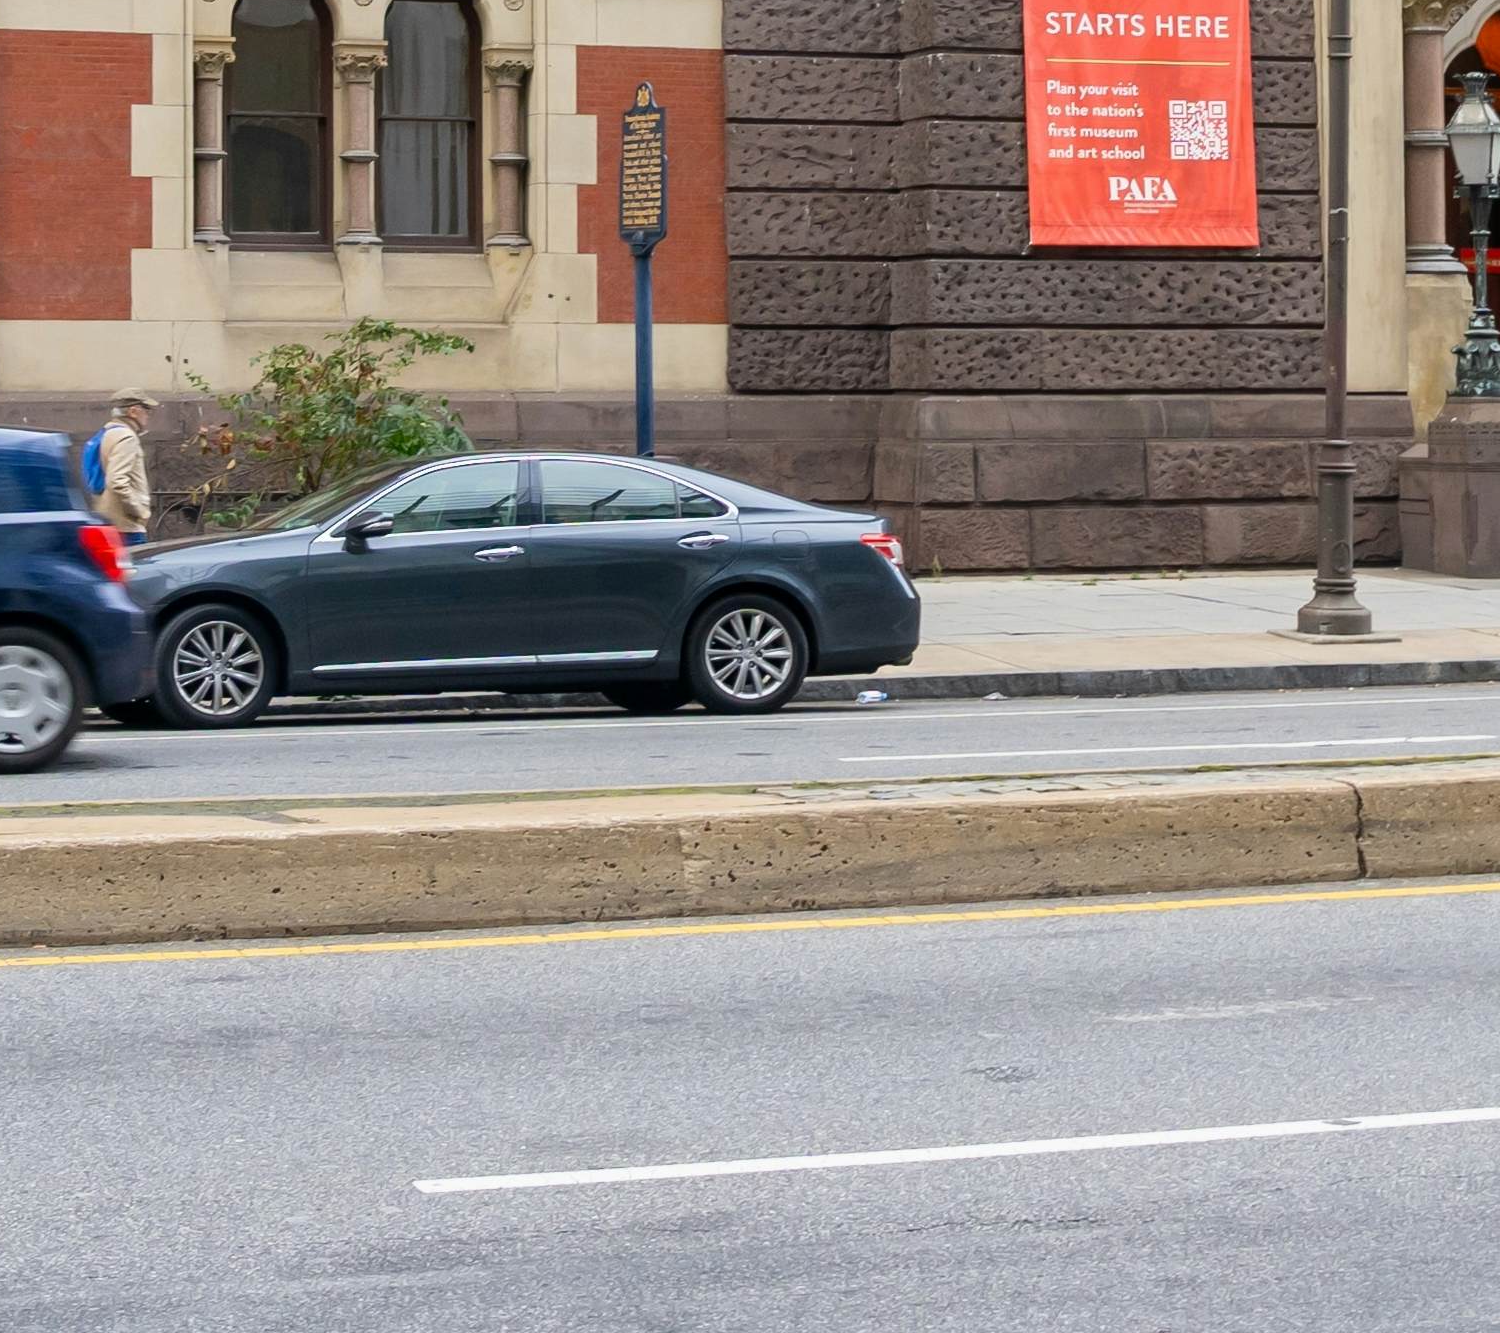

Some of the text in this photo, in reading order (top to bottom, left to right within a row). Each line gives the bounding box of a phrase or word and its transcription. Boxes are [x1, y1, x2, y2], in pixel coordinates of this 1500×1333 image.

[1045, 12, 1229, 38] STARTS HERE
[1046, 80, 1139, 99] Plan your visit
[1047, 102, 1144, 118] to the nation's
[1048, 123, 1138, 138] first museum
[1049, 145, 1145, 160] and art school
[1108, 176, 1178, 201] PAFA
